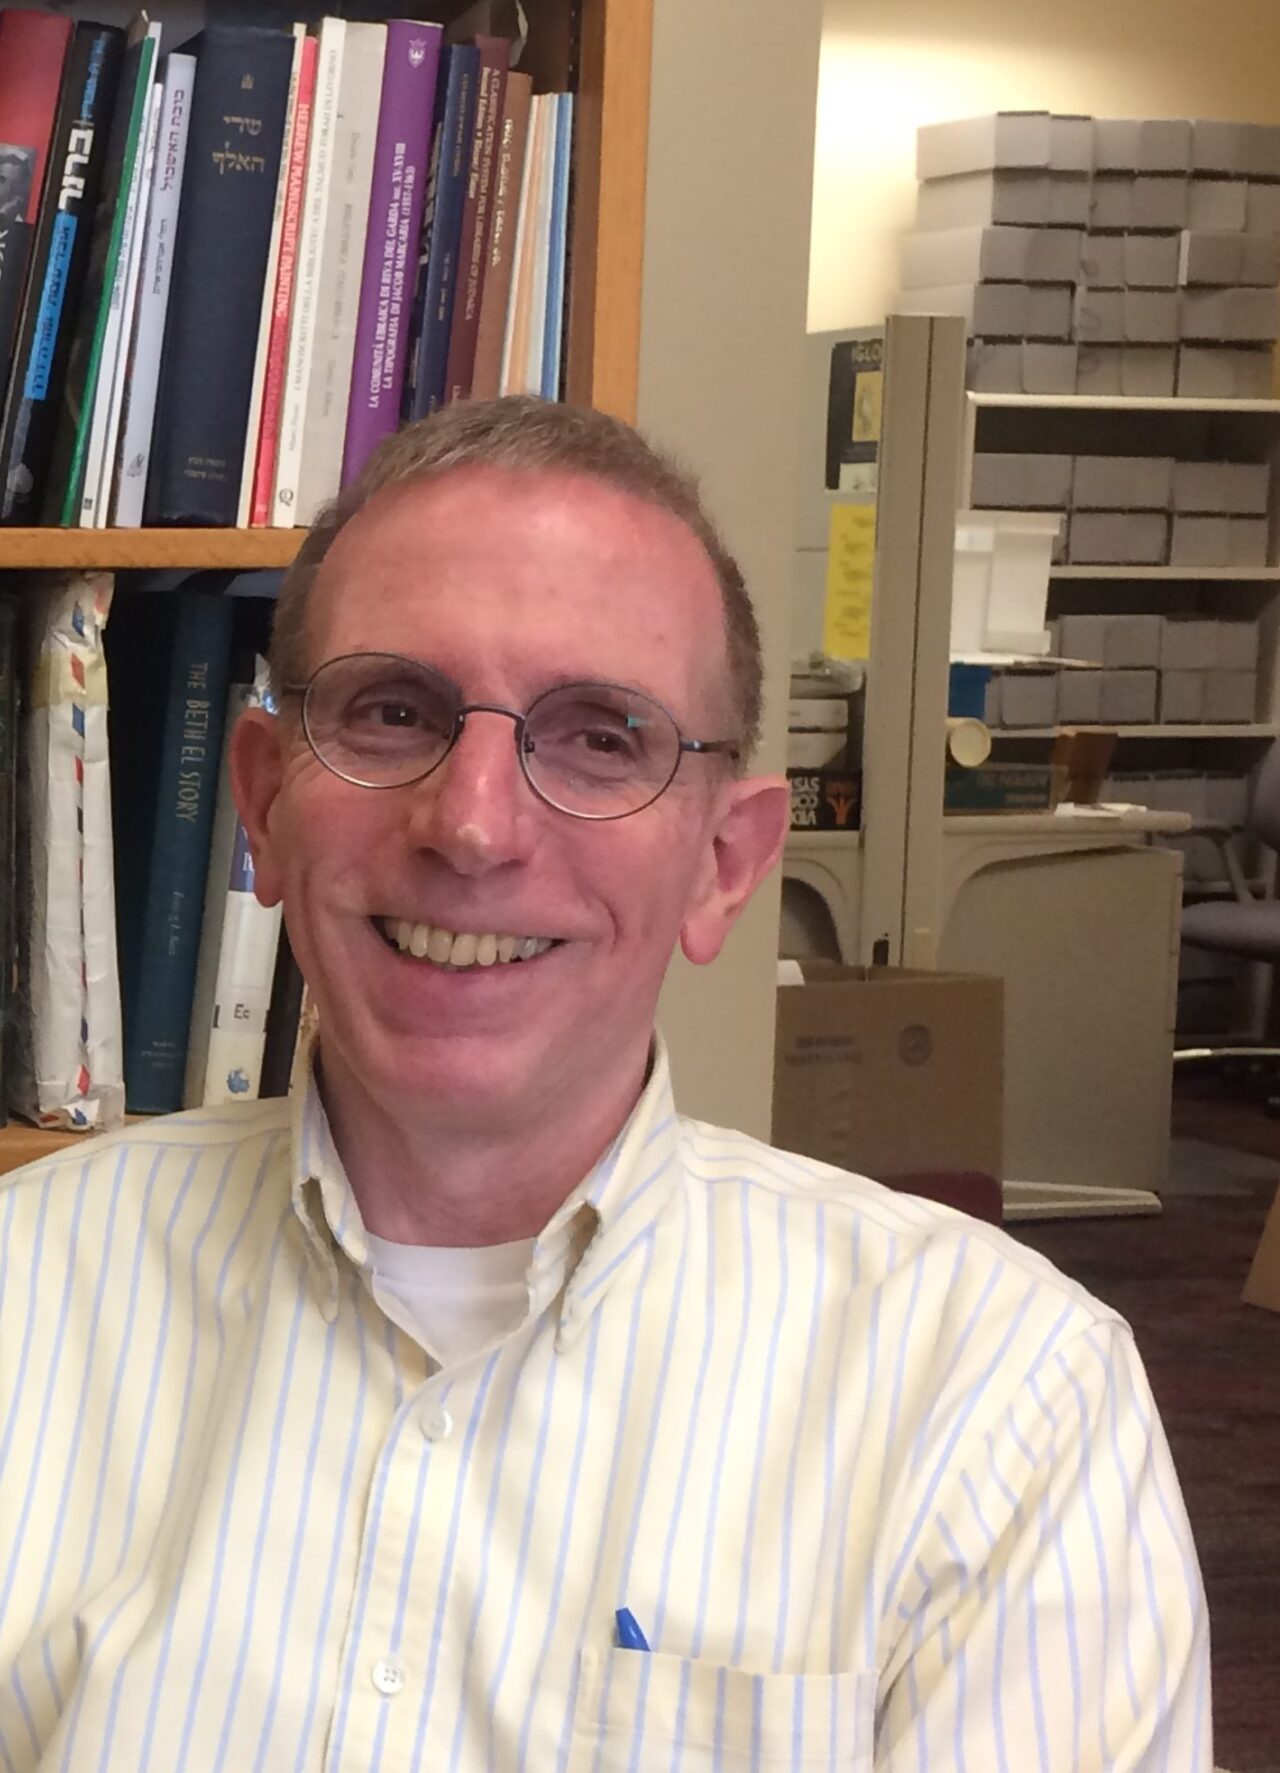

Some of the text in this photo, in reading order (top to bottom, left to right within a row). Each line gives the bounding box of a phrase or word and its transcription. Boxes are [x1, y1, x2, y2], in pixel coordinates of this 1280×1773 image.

[292, 102, 310, 158] HEBREW
[485, 79, 501, 155] CLASSIFICATION
[58, 127, 95, 211] ברנר
[283, 160, 303, 242] MANUSCRIPT
[387, 204, 401, 239] GARDA
[381, 263, 394, 286] RIVA
[384, 240, 396, 261] DEL
[275, 244, 294, 318] PAINTING
[384, 317, 399, 374] TIPOGRAFIA
[395, 218, 411, 269] MARCARIA
[465, 278, 478, 321] JUDAICA
[376, 300, 390, 342] EBRAICA
[371, 343, 385, 393] COMUNITÀ
[174, 661, 209, 825] THE BETH EL STORY
